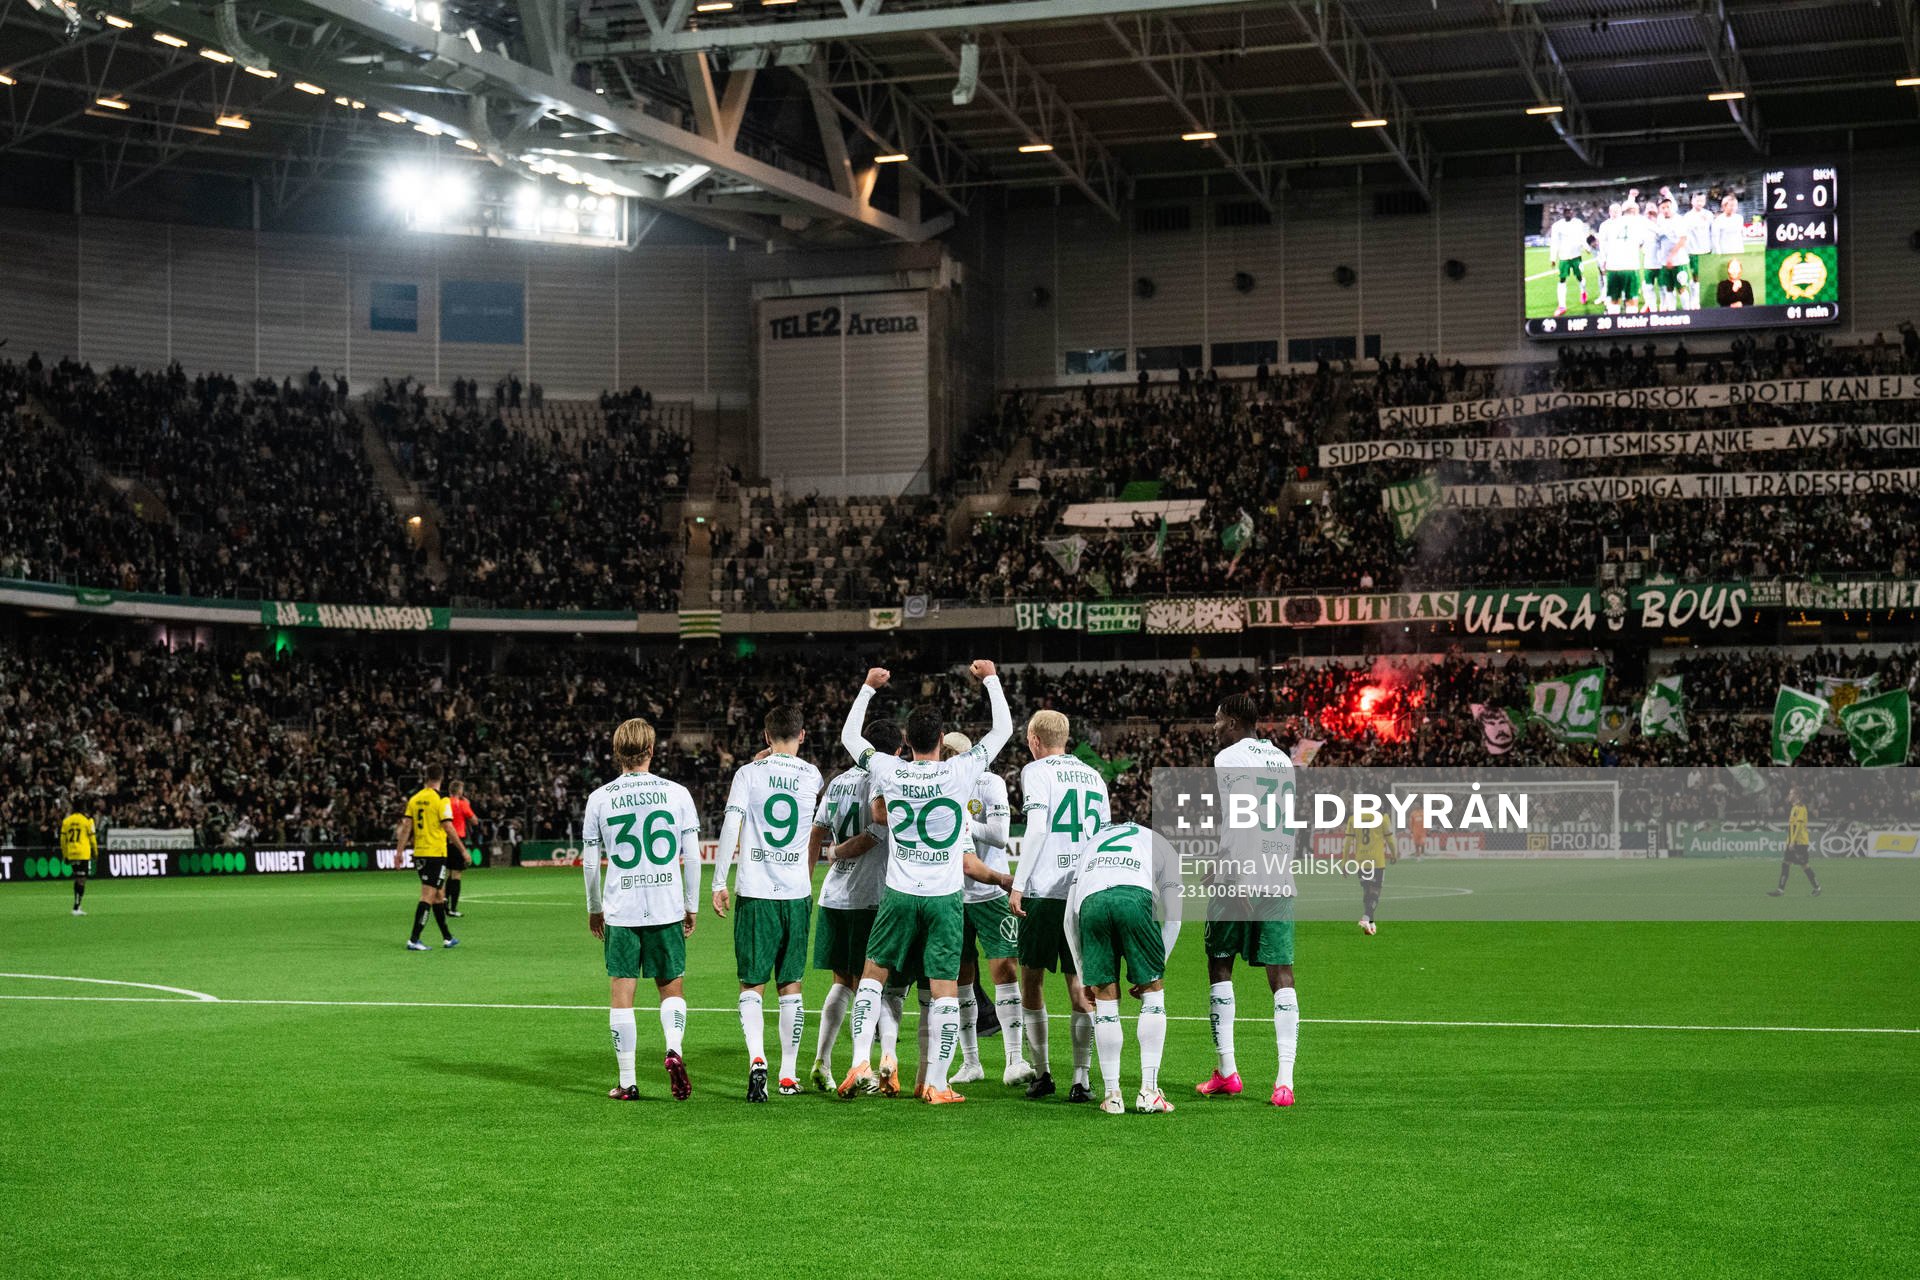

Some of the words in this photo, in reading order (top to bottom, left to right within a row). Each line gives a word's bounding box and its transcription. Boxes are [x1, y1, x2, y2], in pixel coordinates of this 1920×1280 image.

[1774, 188, 1788, 209] 2
[1813, 185, 1827, 206] 0
[1776, 221, 1826, 241] 60:44
[770, 307, 841, 339] TELE2
[847, 313, 918, 335] Arena
[1821, 379, 1869, 401] KAN
[1879, 377, 1902, 396] EJ
[1465, 440, 1523, 459] UTAN
[1088, 606, 1141, 616] SOUTH
[1325, 595, 1457, 621] ULTRAS
[1464, 592, 1596, 634] ULTRA
[1637, 585, 1746, 629] BOYS
[769, 776, 799, 791] NALIĆ
[1057, 771, 1098, 786] RAFFERTY
[611, 792, 667, 809] KARLSSON
[902, 784, 943, 799] BESARA
[417, 809, 425, 829] 5
[763, 793, 799, 848] 9
[887, 798, 962, 850] 20
[1052, 789, 1103, 842] 45
[68, 828, 81, 842] 27
[607, 810, 677, 869] 36
[1097, 826, 1139, 852] 2
[1551, 834, 1621, 849] PROJOB
[1690, 837, 1816, 851] AudicomPenx
[109, 853, 168, 877] UNIBET
[255, 851, 305, 872] UNIBET
[764, 850, 800, 862] PROJOB
[908, 850, 949, 862] PROJOB
[1097, 856, 1142, 869] PROJOB
[634, 873, 673, 884] PROJOB
[854, 999, 872, 1038] Clinton.
[939, 1023, 959, 1061] Clinton.
